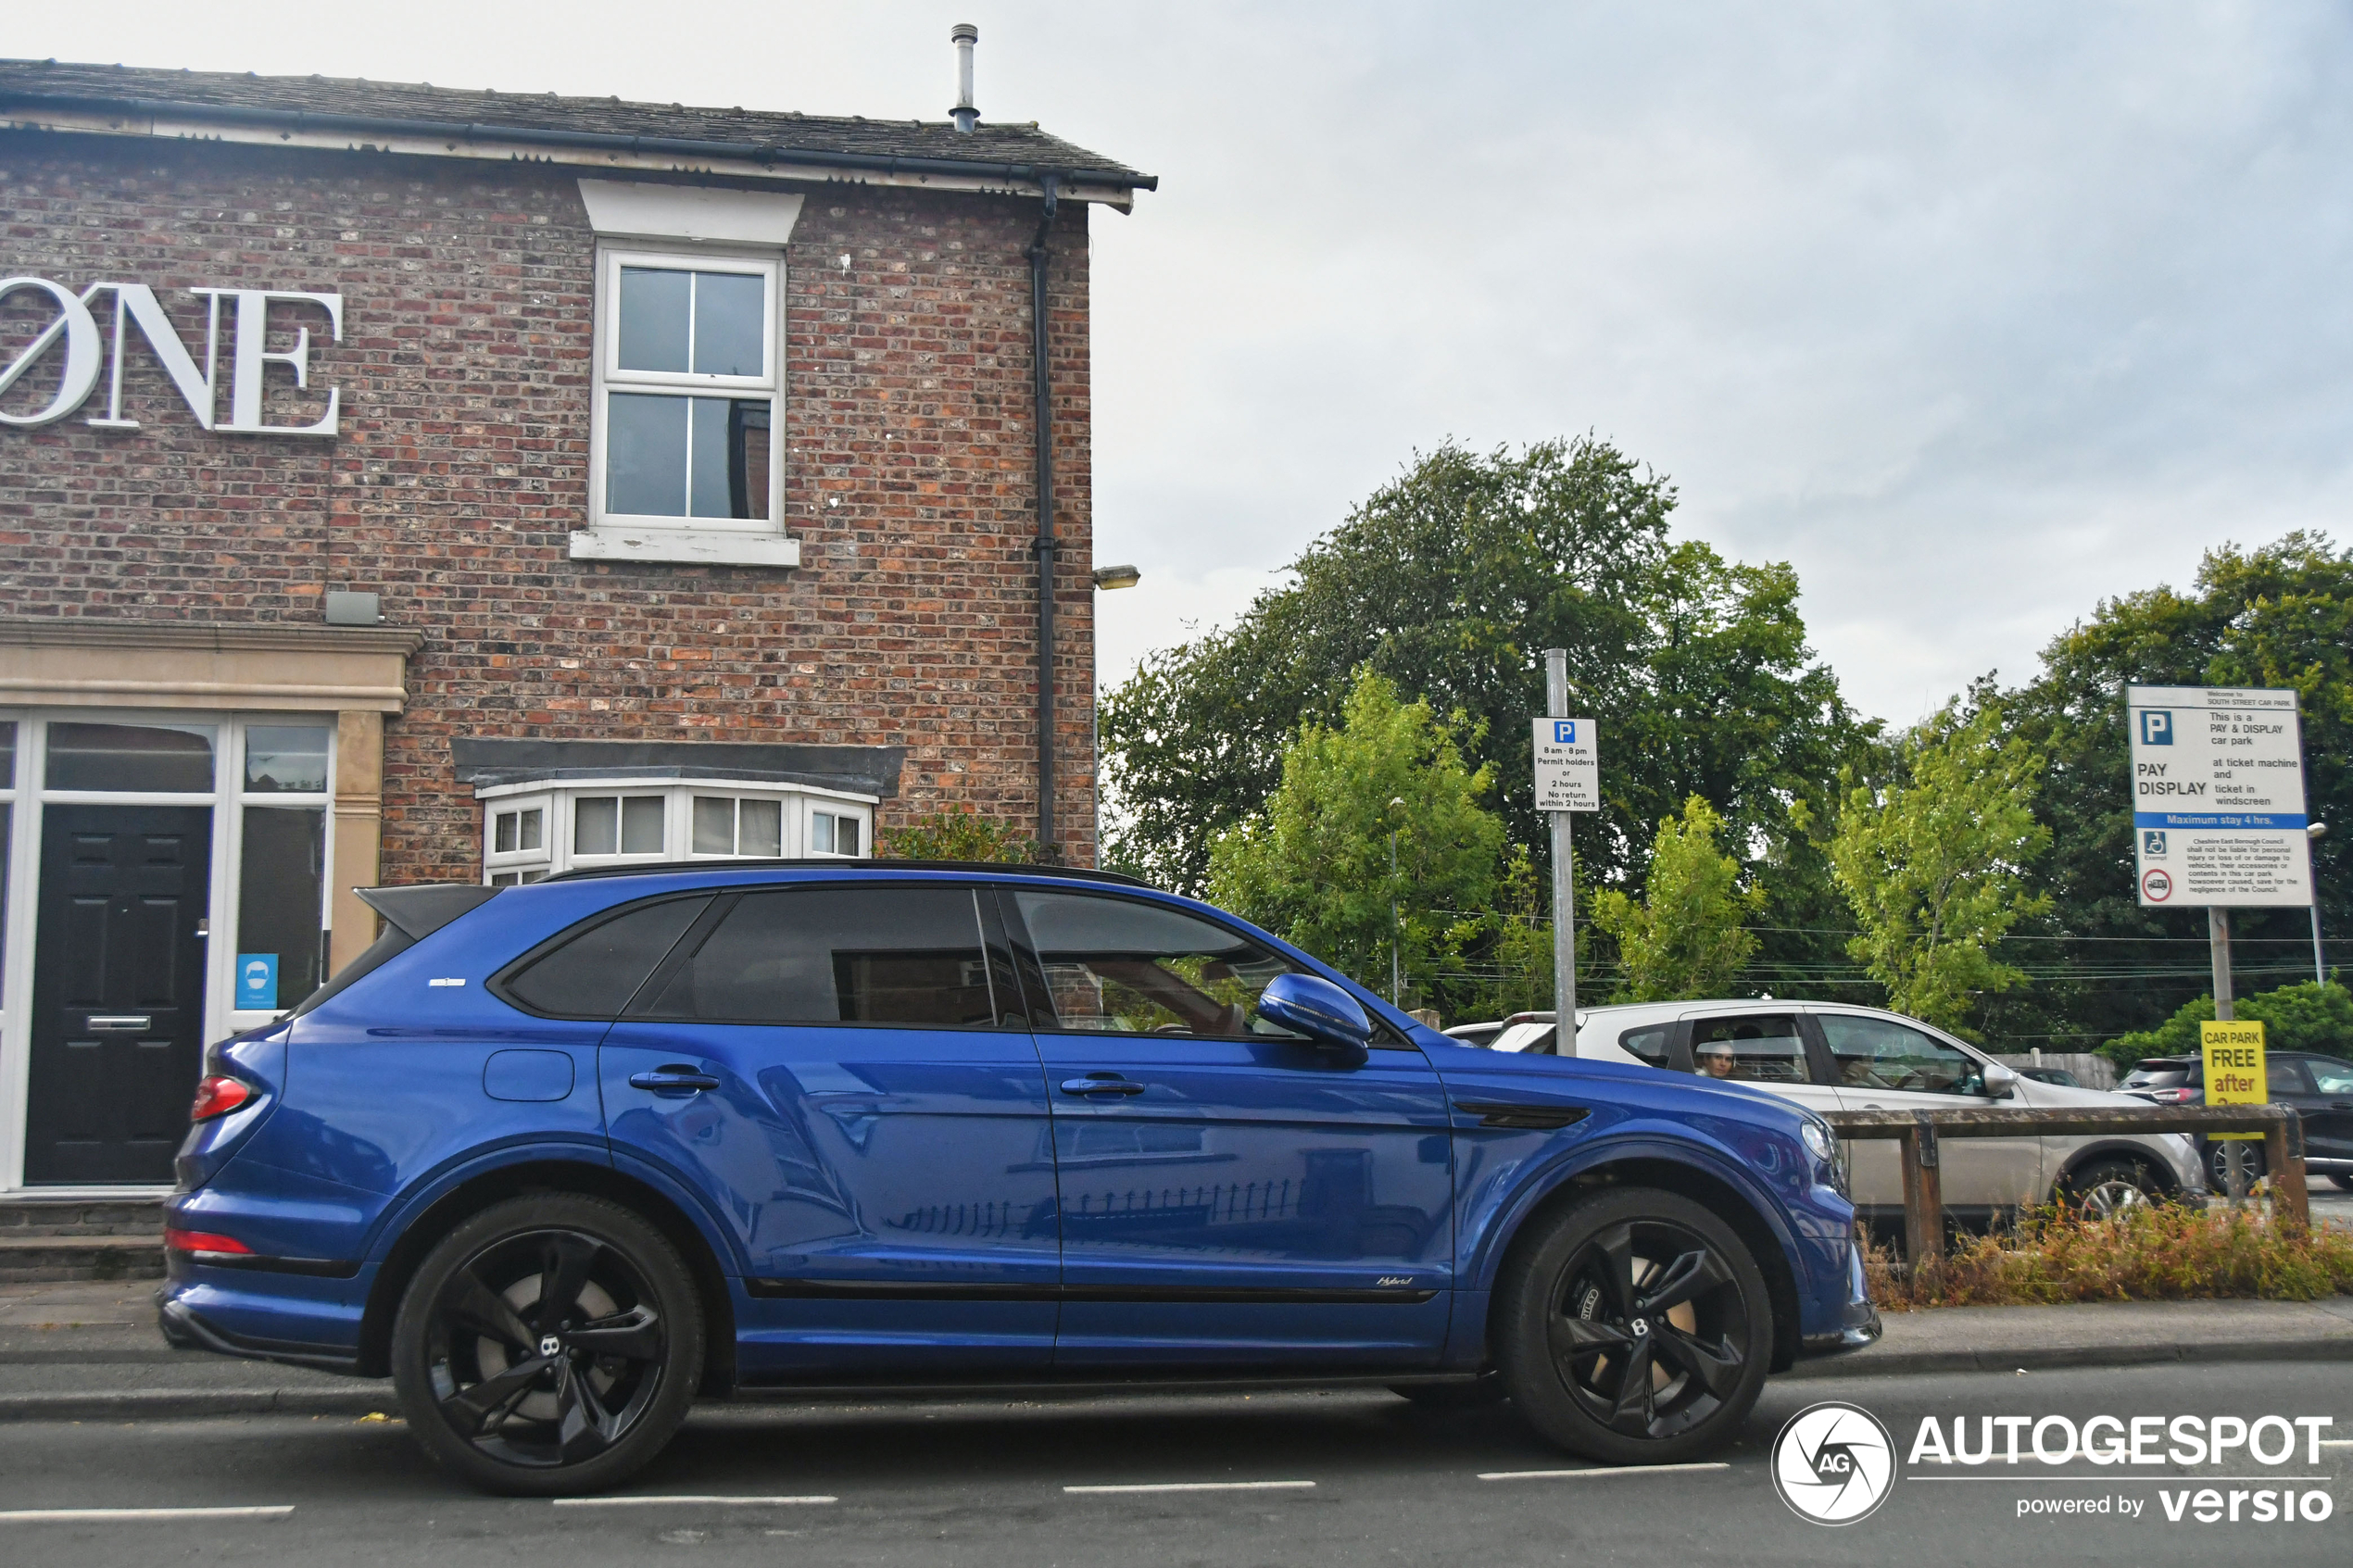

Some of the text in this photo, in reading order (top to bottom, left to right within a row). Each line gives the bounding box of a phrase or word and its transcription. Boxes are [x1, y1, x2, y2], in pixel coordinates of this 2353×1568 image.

[2209, 712, 2229, 721] This
[2233, 713, 2242, 721] is
[1559, 724, 1571, 741] P
[2145, 713, 2166, 742] P
[2210, 724, 2283, 734] PAY & DISPLAY
[2231, 737, 2253, 746] park
[2227, 759, 2254, 767] ticket
[2259, 759, 2297, 768] machine
[2137, 763, 2167, 776] PAY
[2214, 770, 2232, 778] and
[2139, 782, 2207, 795] DISPLAY
[2215, 784, 2255, 793] ticket in
[2216, 797, 2271, 805] windscreen
[2167, 815, 2273, 826] Maximum stay 4 hrs.
[2205, 1032, 2259, 1044] CAR PARK
[2211, 1048, 2256, 1067] FREE
[2215, 1073, 2255, 1092] after
[1377, 1276, 1413, 1286] Hybrid
